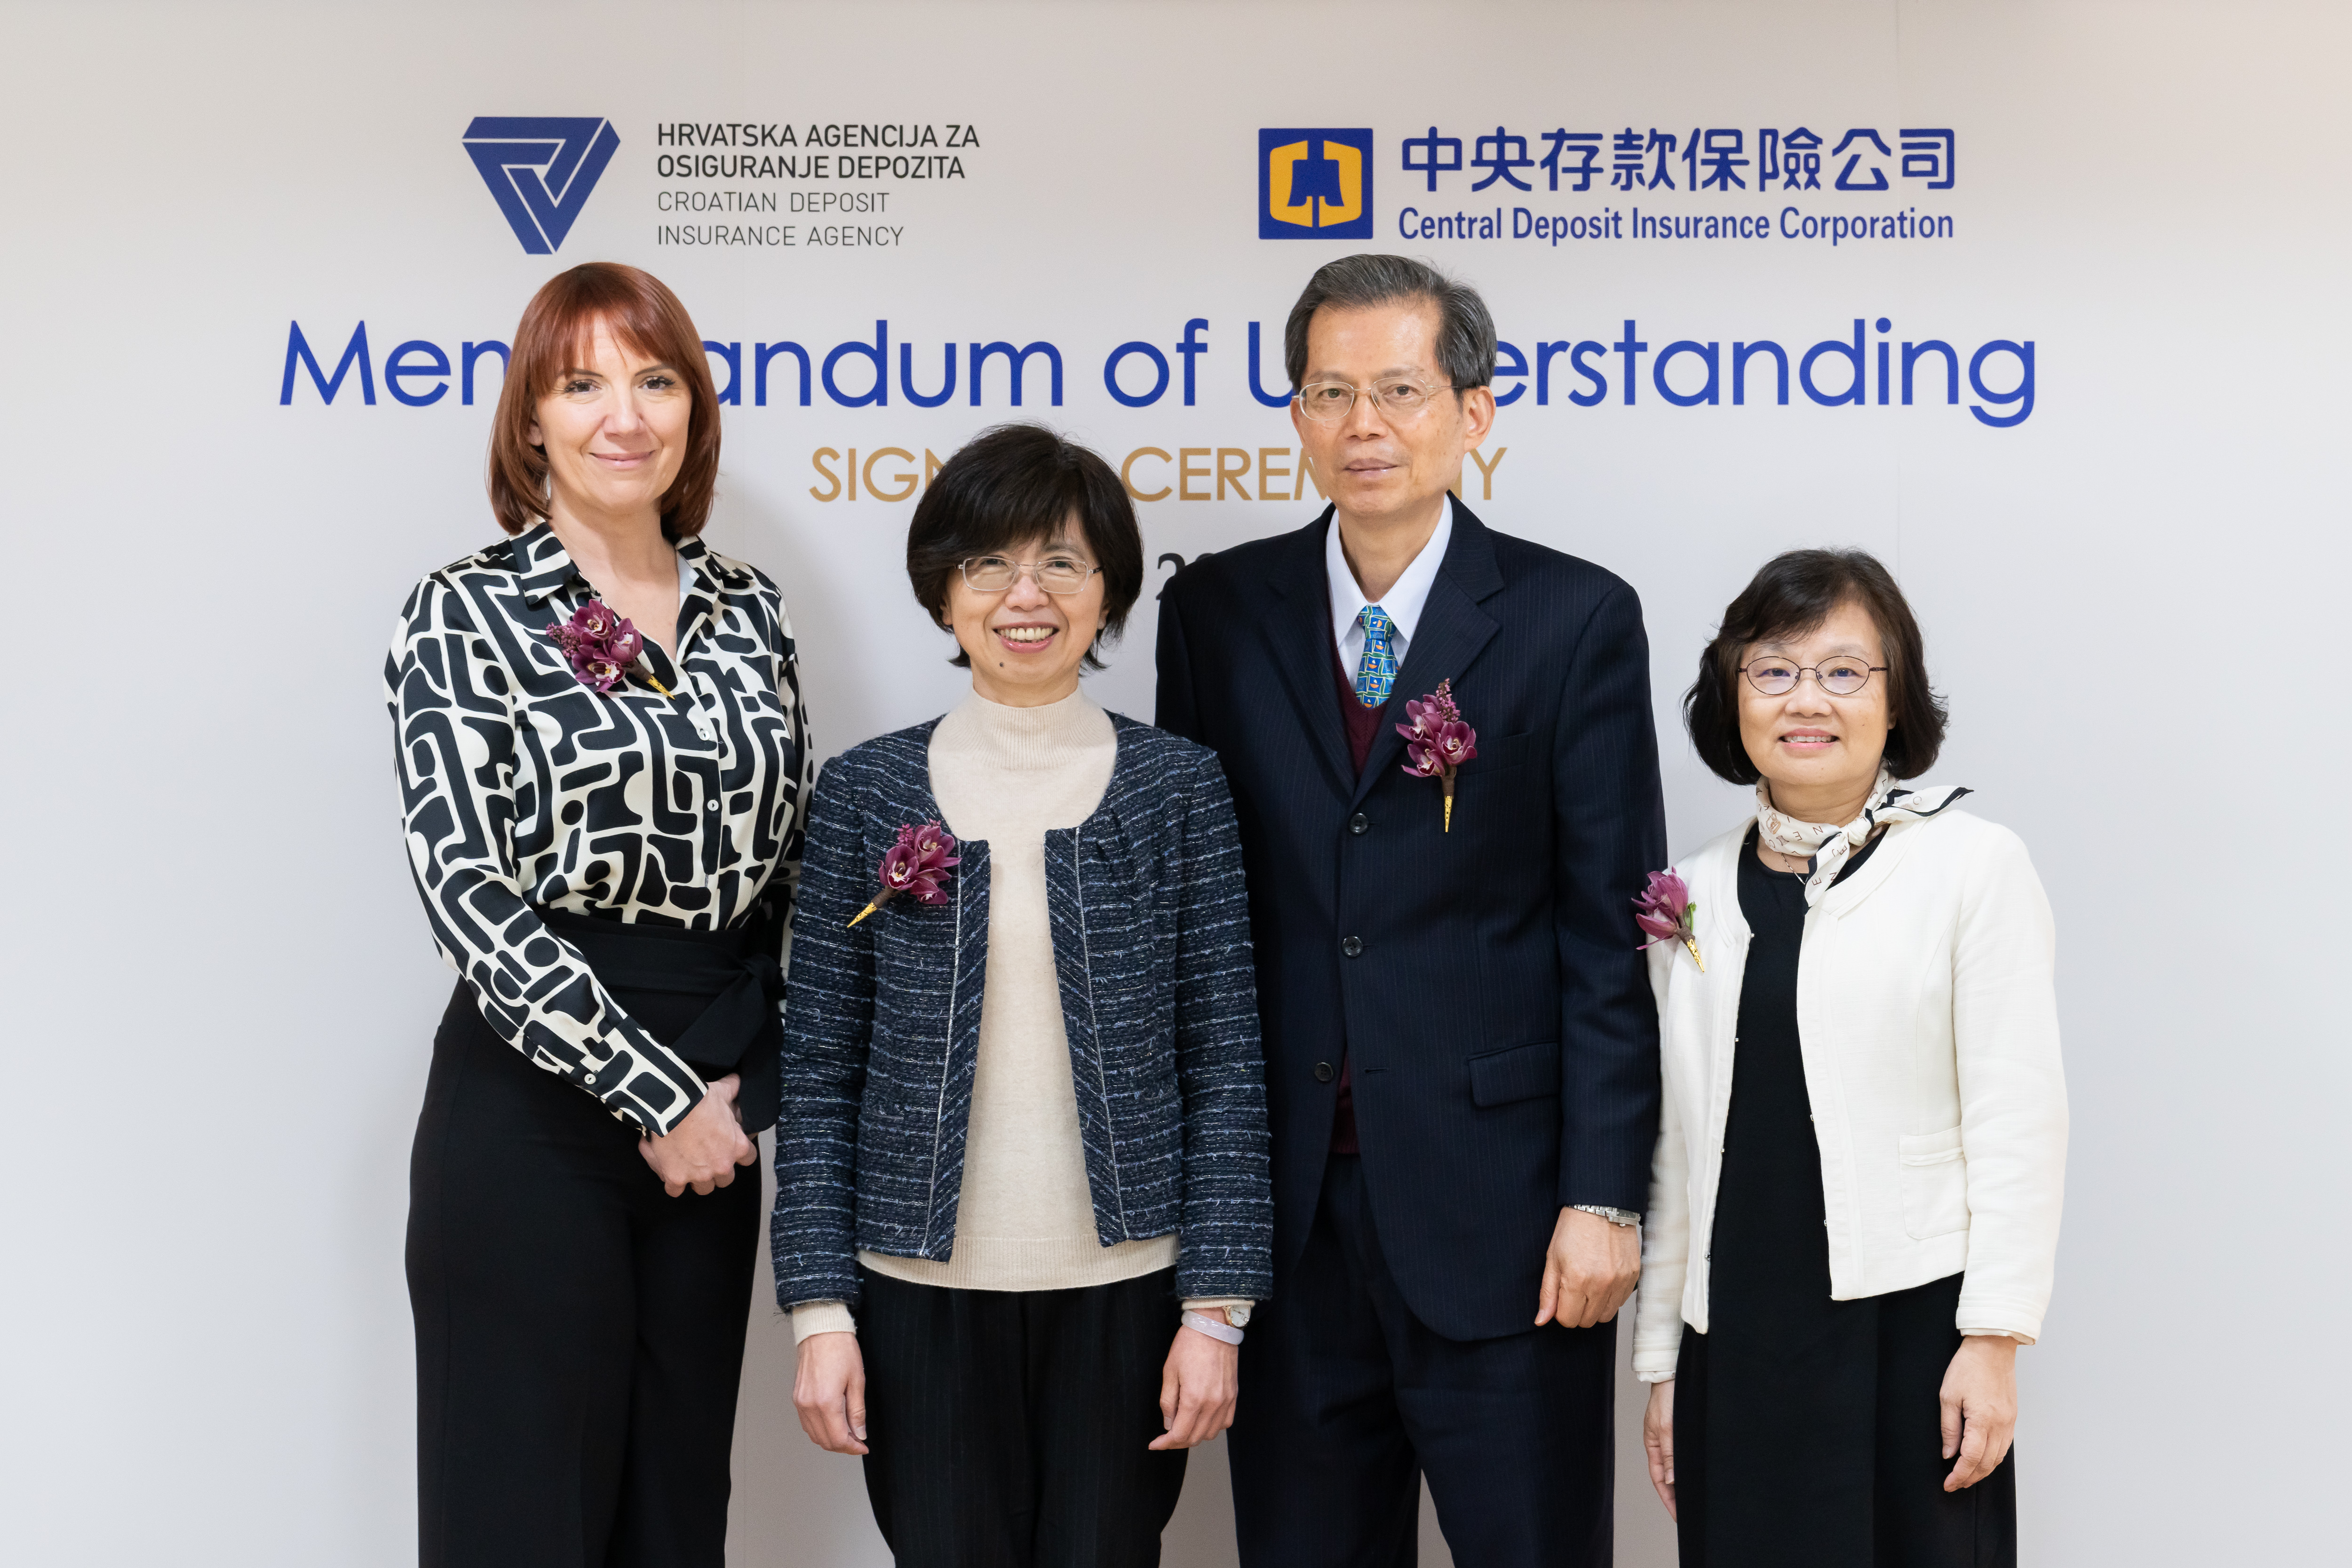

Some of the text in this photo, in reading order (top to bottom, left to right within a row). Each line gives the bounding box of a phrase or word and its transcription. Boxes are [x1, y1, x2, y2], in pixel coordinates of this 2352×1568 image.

[658, 124, 980, 148] HRVATSKA AGENCIJA ZA
[658, 154, 966, 179] OSIGURANJE DEPOZITA
[1402, 126, 1955, 192] 中央存款保險公司
[658, 191, 890, 213] CROATIAN DEPOSIT
[658, 225, 905, 247] INSURANCE AGENCY
[1399, 207, 1954, 247] Central Deposit Insurance Corporation
[279, 318, 2035, 429] Meandum of Uerstanding
[1121, 446, 1508, 502] CEREY
